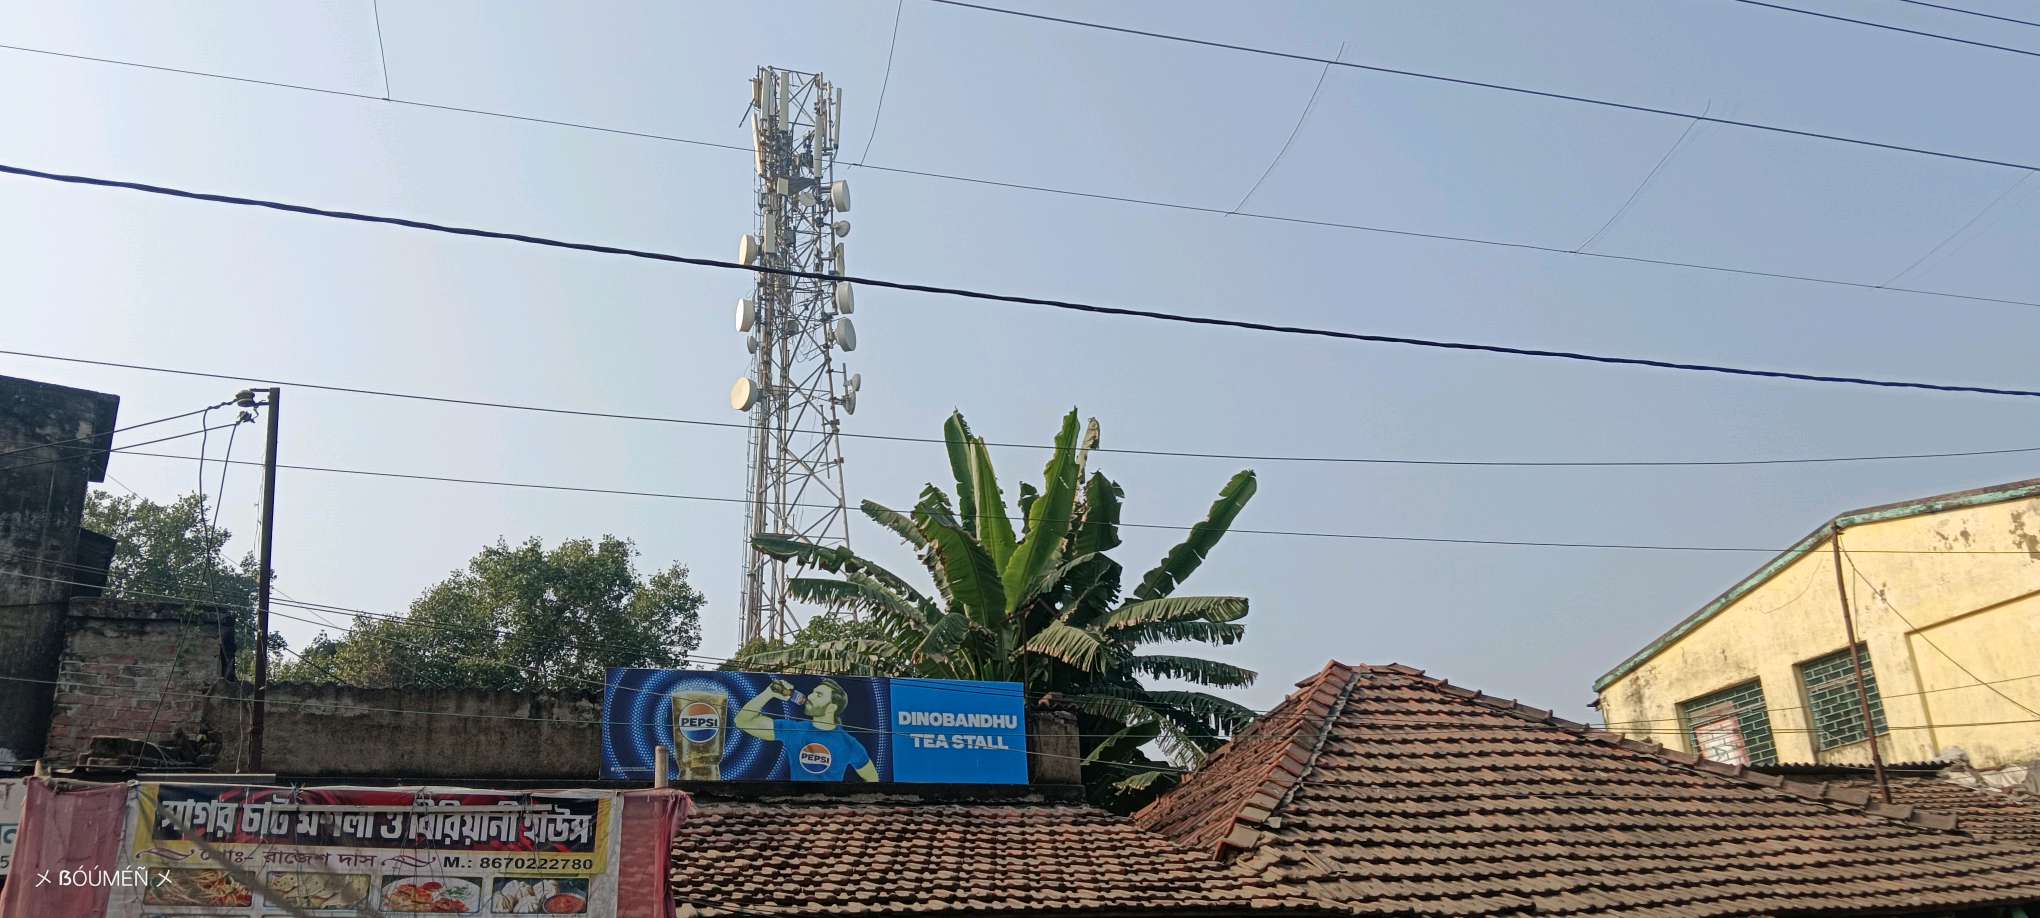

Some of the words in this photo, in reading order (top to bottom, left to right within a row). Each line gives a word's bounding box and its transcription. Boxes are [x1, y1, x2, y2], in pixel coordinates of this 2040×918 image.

[681, 717, 718, 727] PEPSI
[898, 711, 1018, 729] DINOBANDHU
[910, 733, 949, 749] TEA
[951, 734, 1009, 750] STALL
[801, 752, 830, 764] PEPSI
[161, 798, 238, 838] সাগর
[337, 851, 377, 867] দাস
[479, 856, 593, 870] 8670222780
